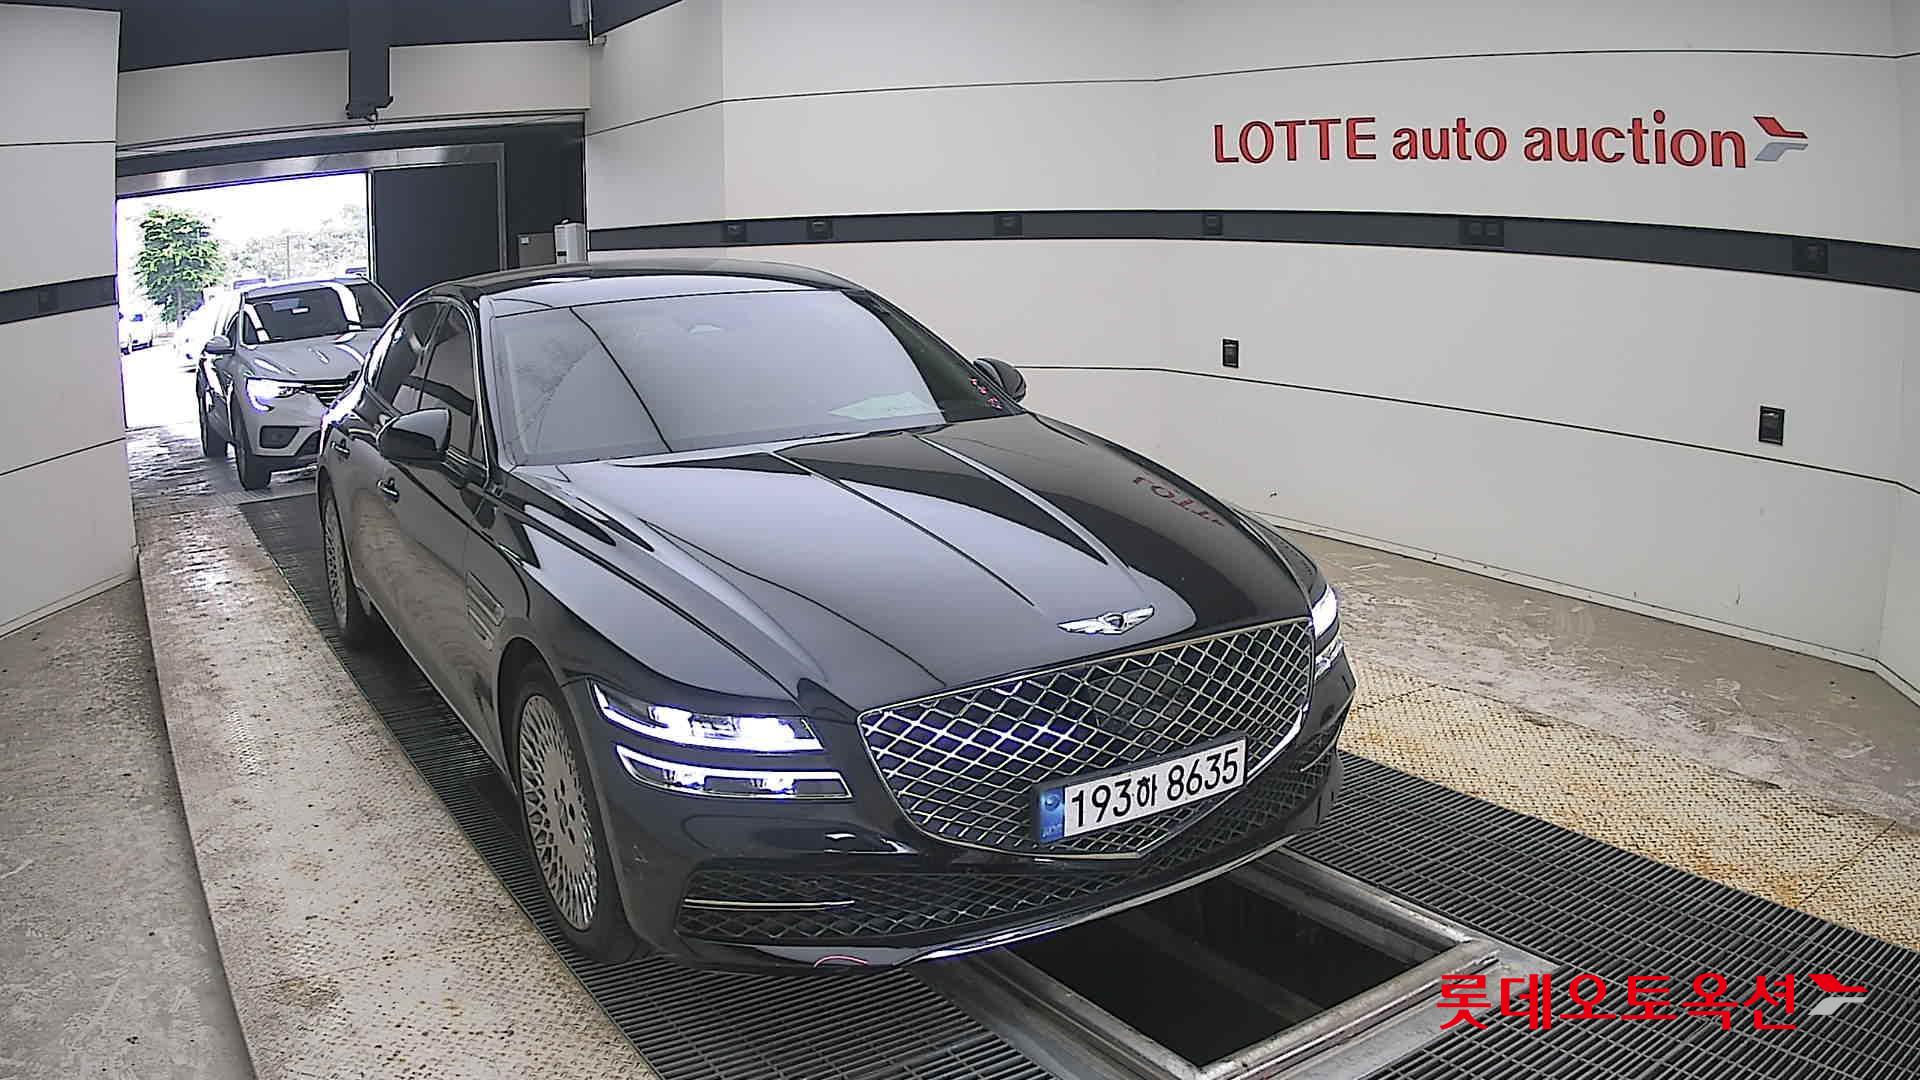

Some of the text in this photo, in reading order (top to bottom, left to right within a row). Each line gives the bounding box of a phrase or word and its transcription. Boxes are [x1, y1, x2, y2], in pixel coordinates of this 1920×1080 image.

[1213, 109, 1746, 169] LOTTE auto auction
[1071, 748, 1239, 828] 193하 8635
